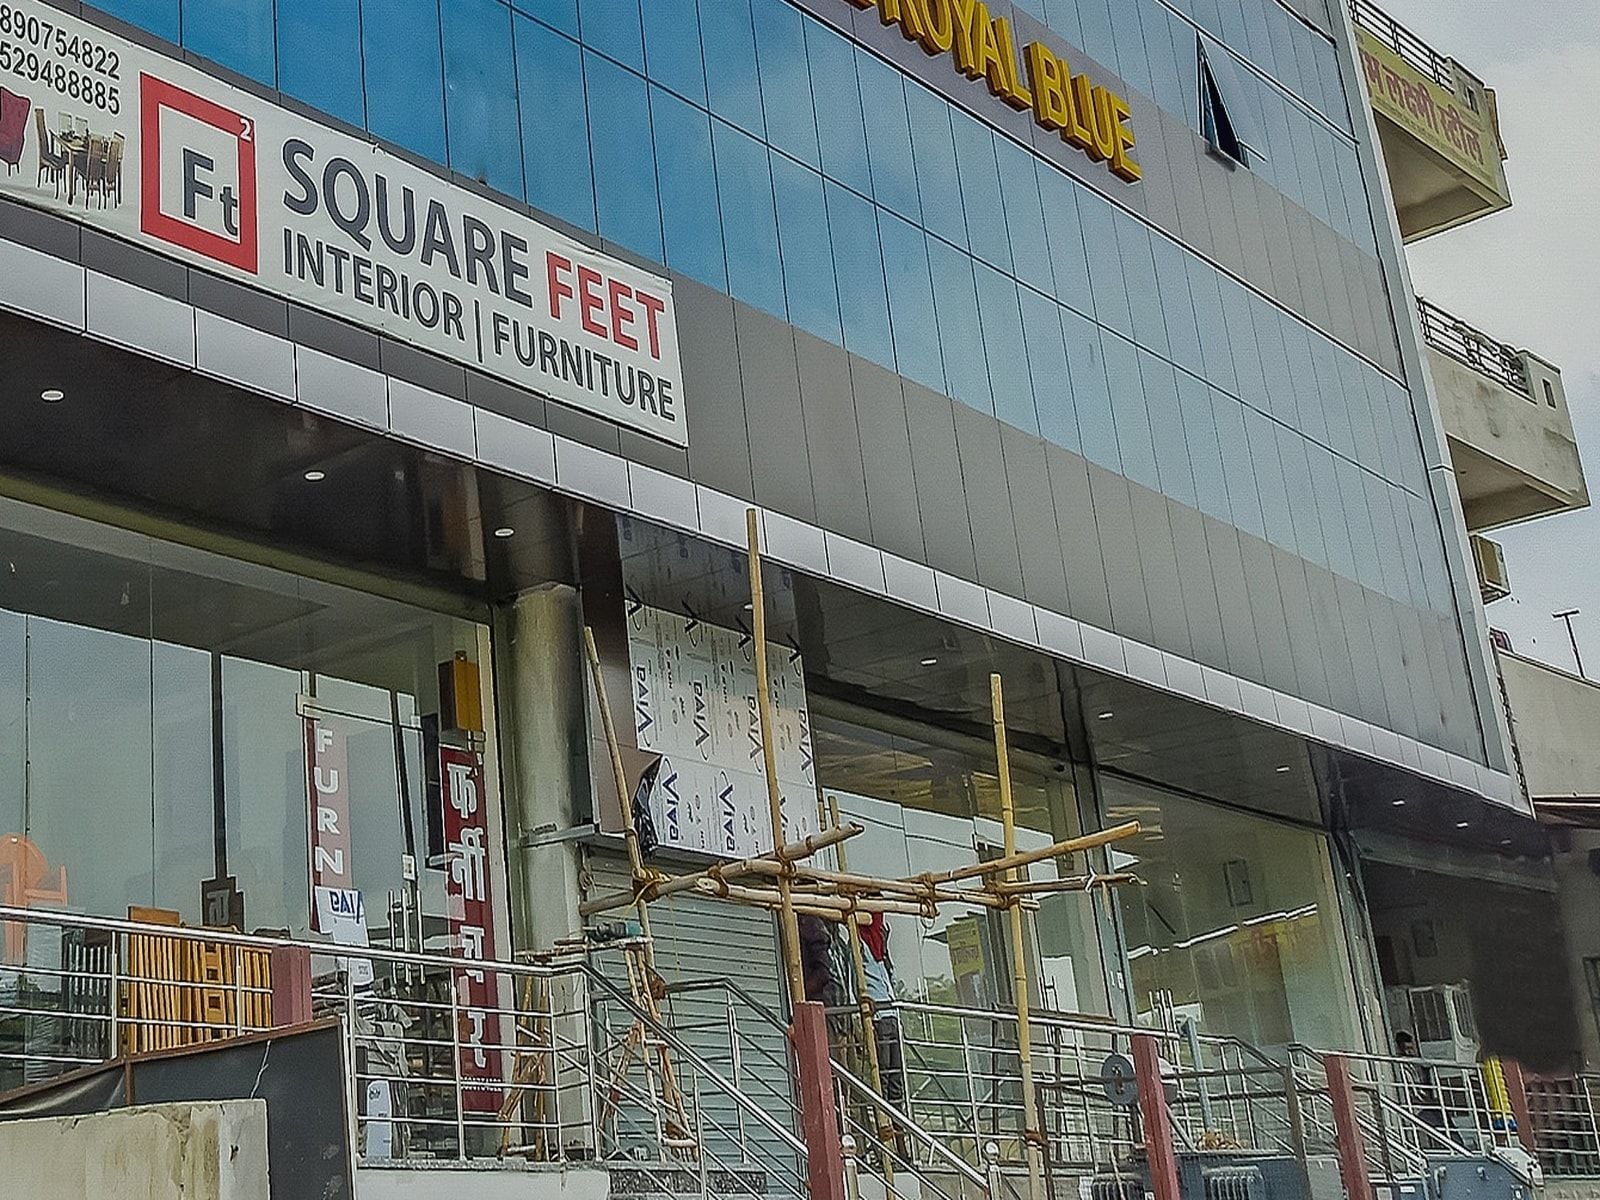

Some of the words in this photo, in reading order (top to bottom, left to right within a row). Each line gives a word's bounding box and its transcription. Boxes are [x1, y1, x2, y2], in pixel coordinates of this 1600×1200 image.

[182, 147, 241, 237] Ft
[1023, 41, 1142, 184] BLUE
[281, 139, 535, 308] SQUARE
[547, 251, 665, 359] FEET
[283, 229, 466, 341] INTERIOR
[494, 314, 676, 422] FURNITURE
